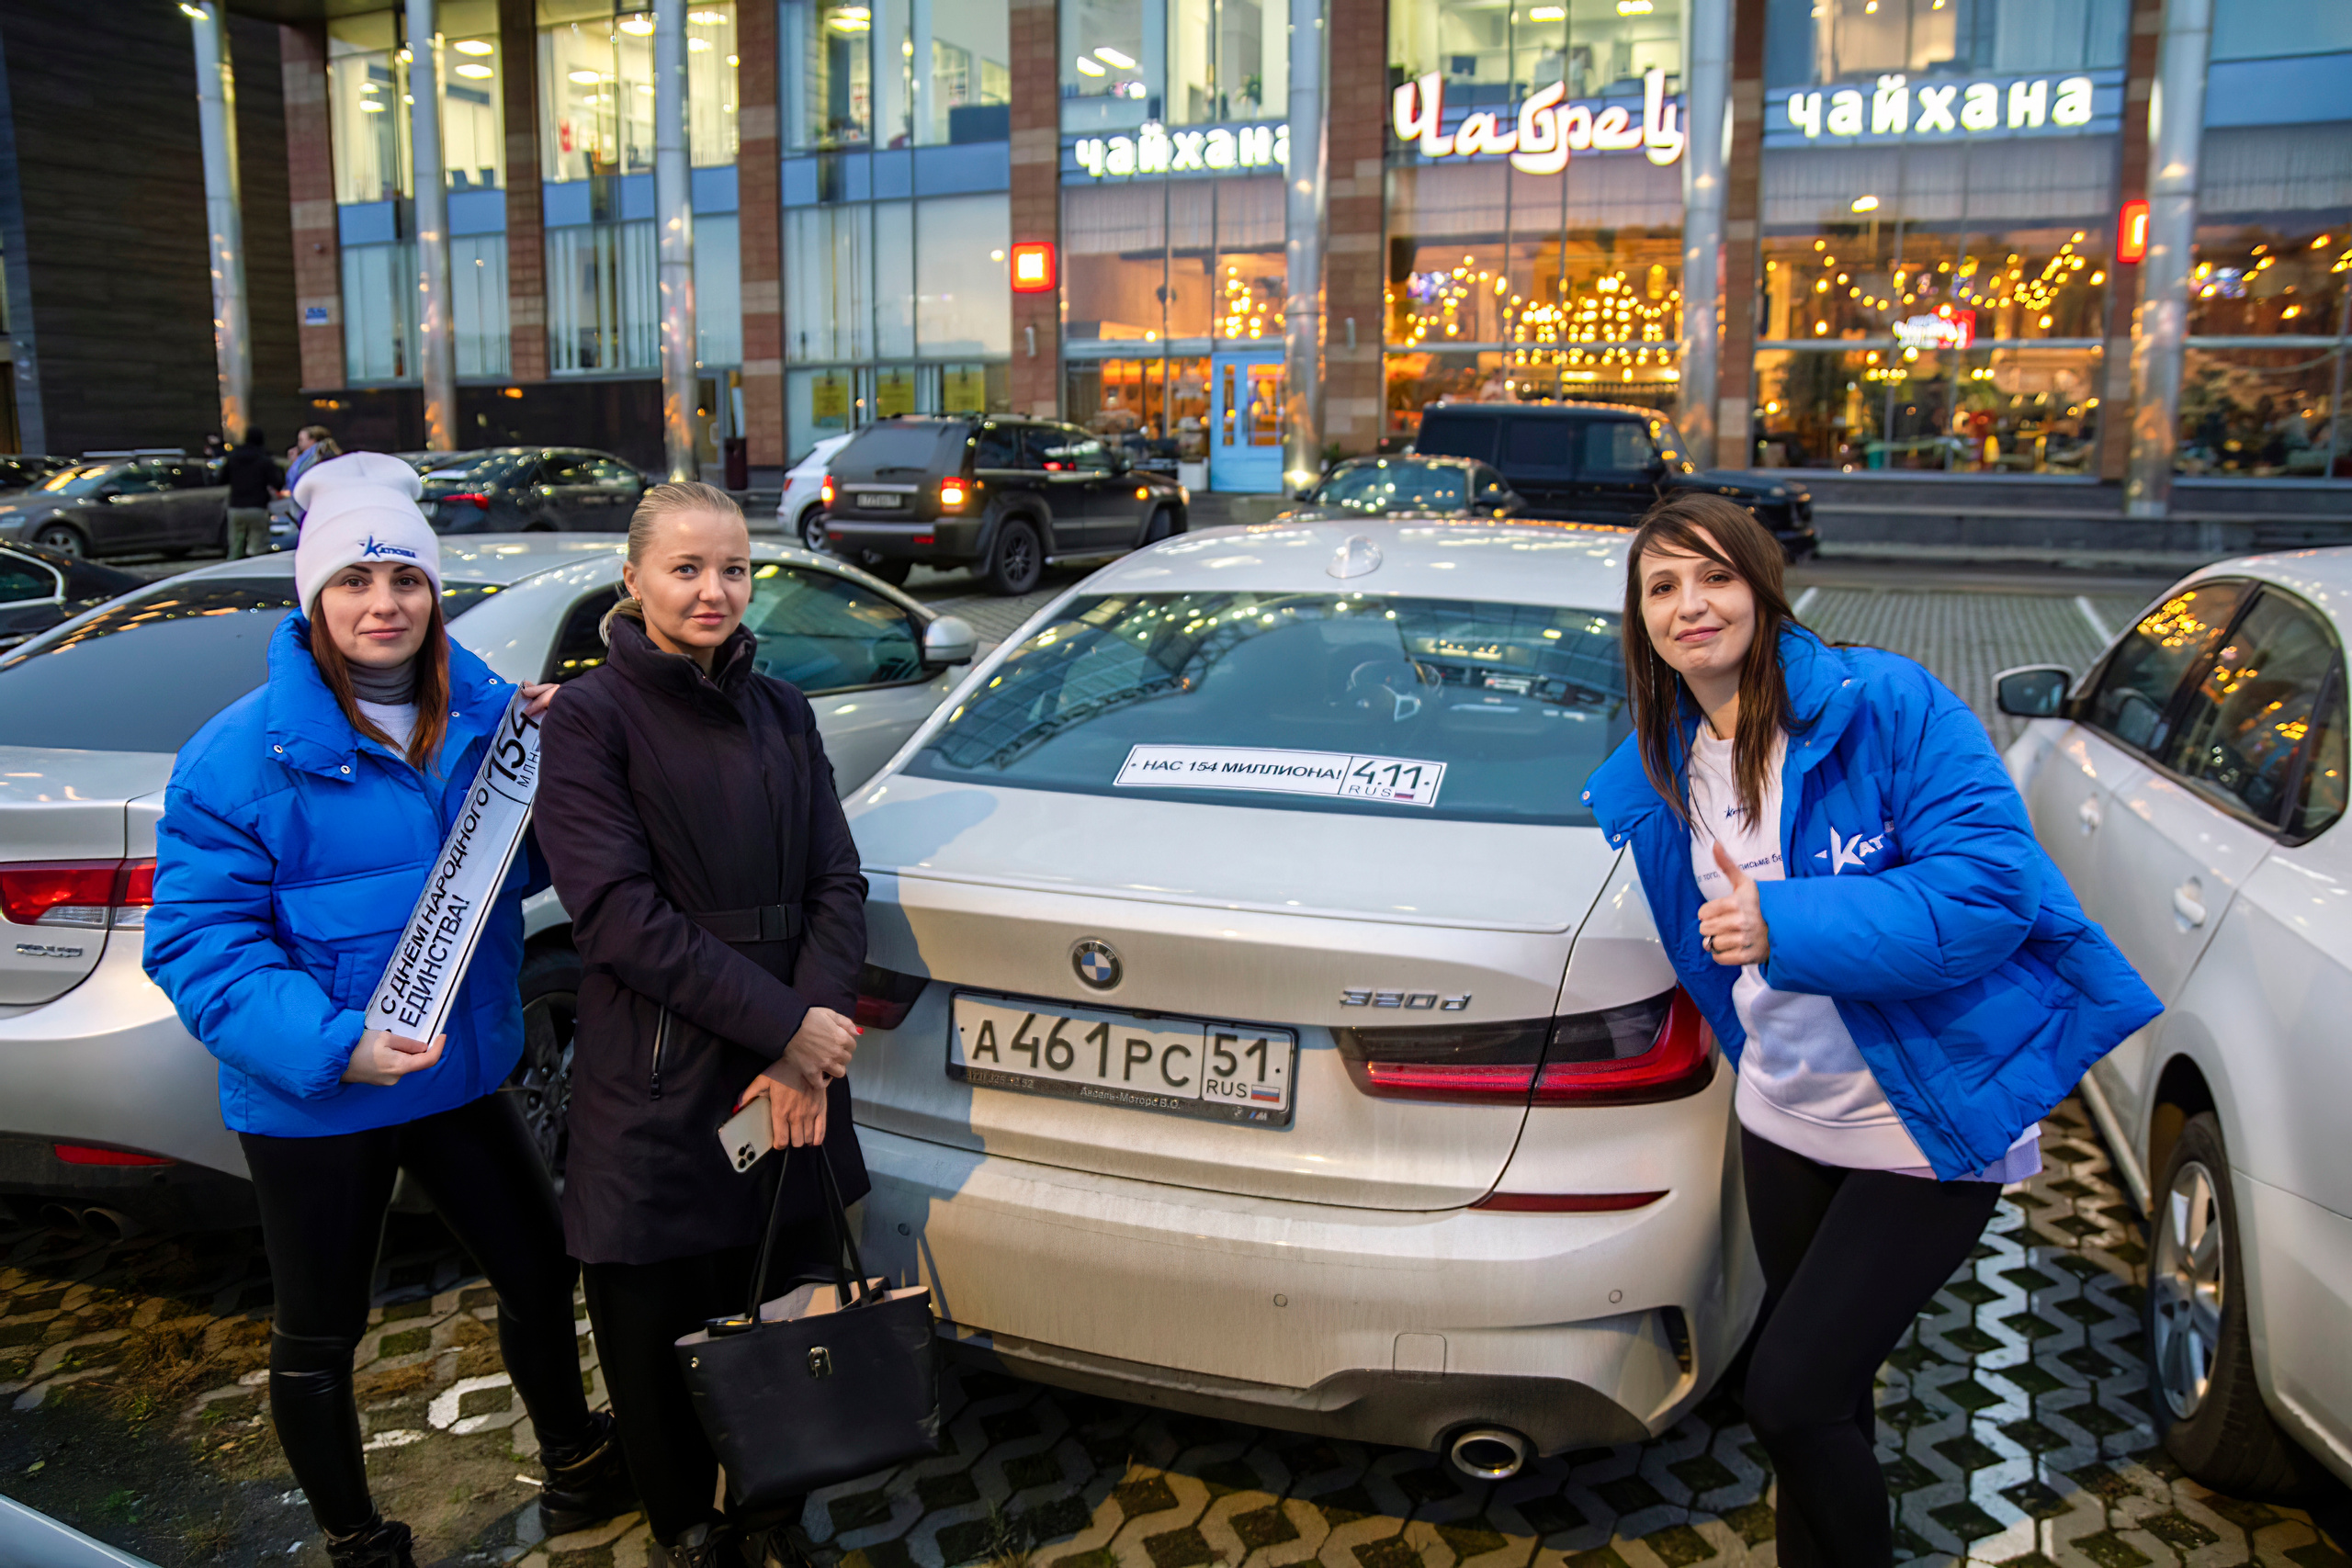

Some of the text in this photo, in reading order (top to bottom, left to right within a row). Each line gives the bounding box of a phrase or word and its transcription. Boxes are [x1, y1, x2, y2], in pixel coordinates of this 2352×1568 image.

[1788, 74, 2093, 138] чайхана
[487, 705, 539, 782] 154
[1143, 759, 1342, 781] НАС 154 МИЛЛИОНА!
[1348, 784, 1392, 798] RUS
[380, 995, 396, 1015] С
[421, 787, 489, 926] НАРОДНОГО
[398, 894, 470, 1028] ЕДИНСТВА!
[972, 1013, 1192, 1088] А461РС
[1212, 1032, 1268, 1082] 51
[1205, 1078, 1248, 1099] RUS
